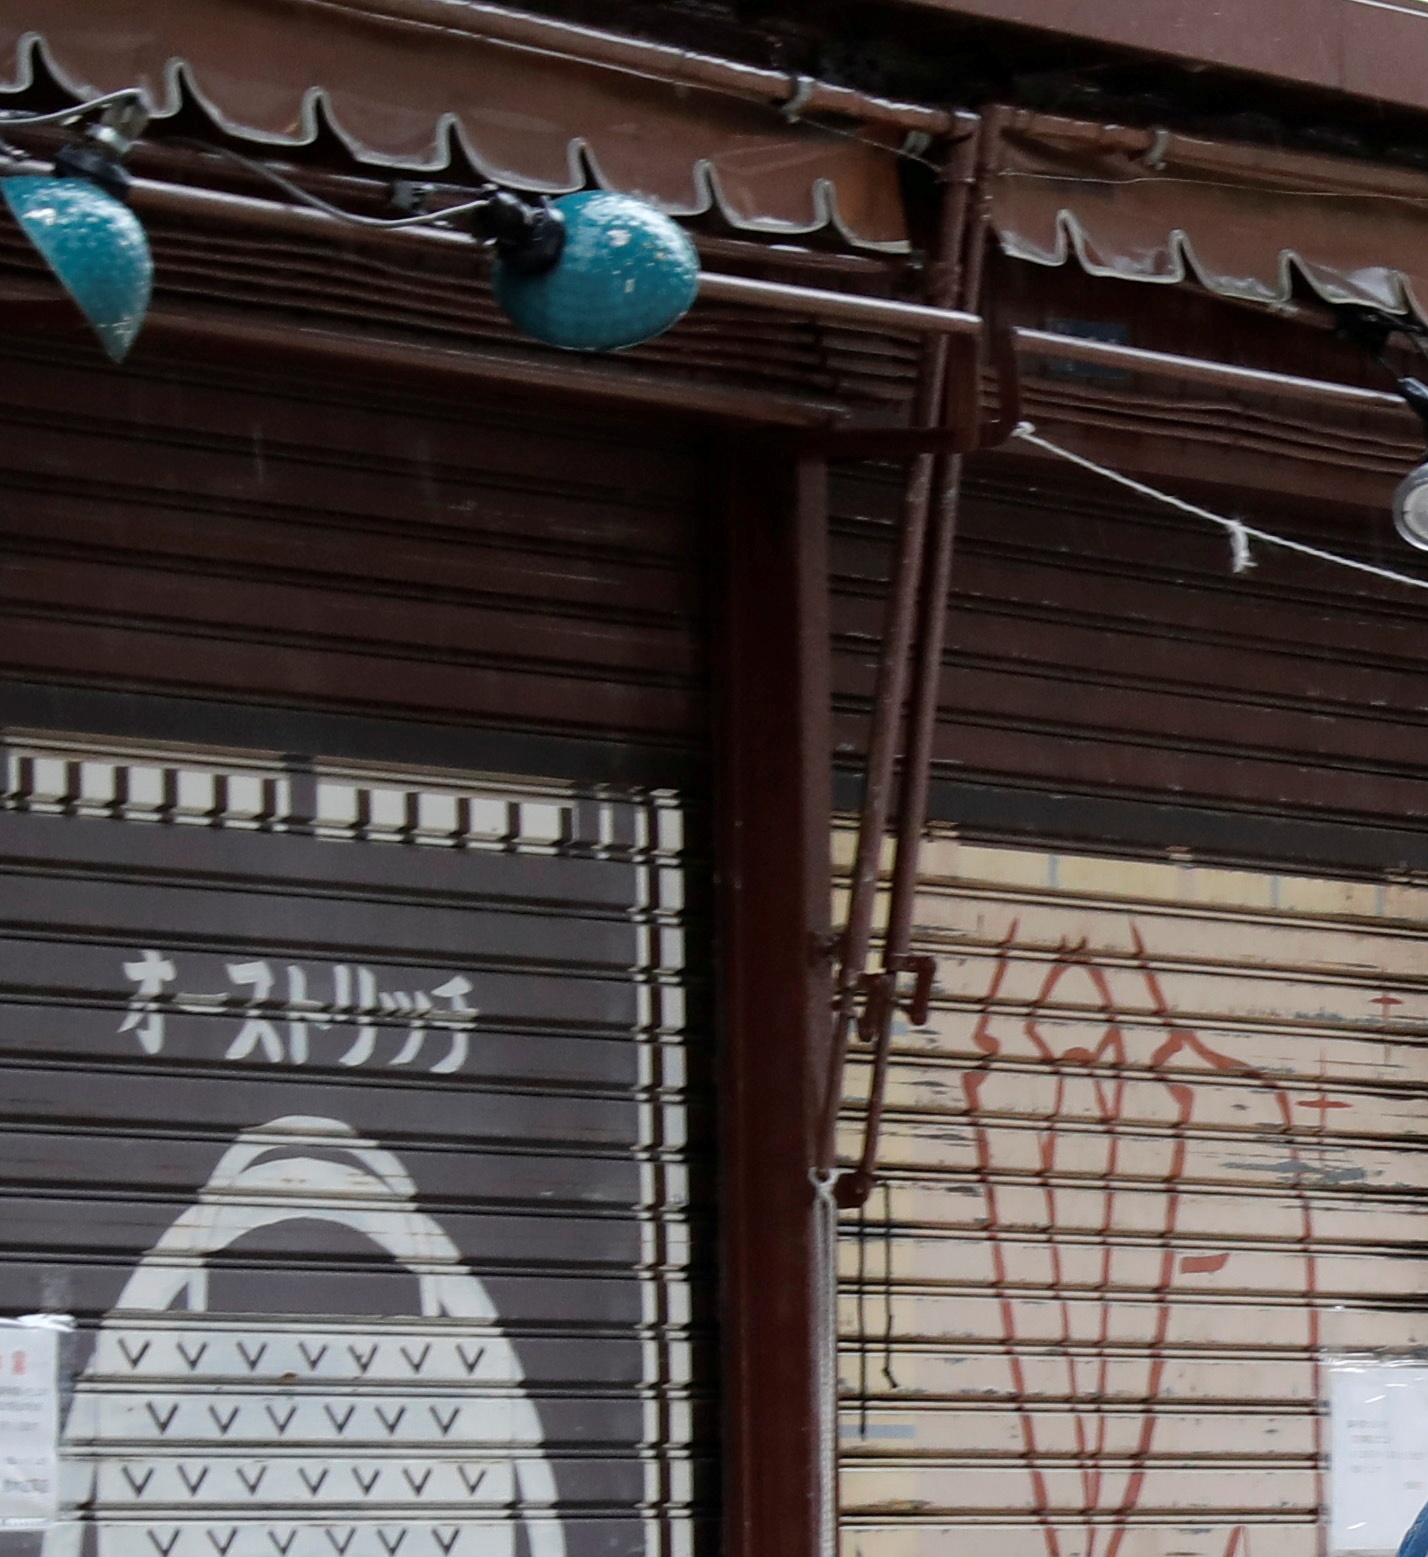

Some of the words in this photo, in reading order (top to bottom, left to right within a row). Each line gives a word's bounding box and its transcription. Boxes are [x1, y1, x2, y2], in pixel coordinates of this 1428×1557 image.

[116, 948, 480, 1076] オーストリッチ
